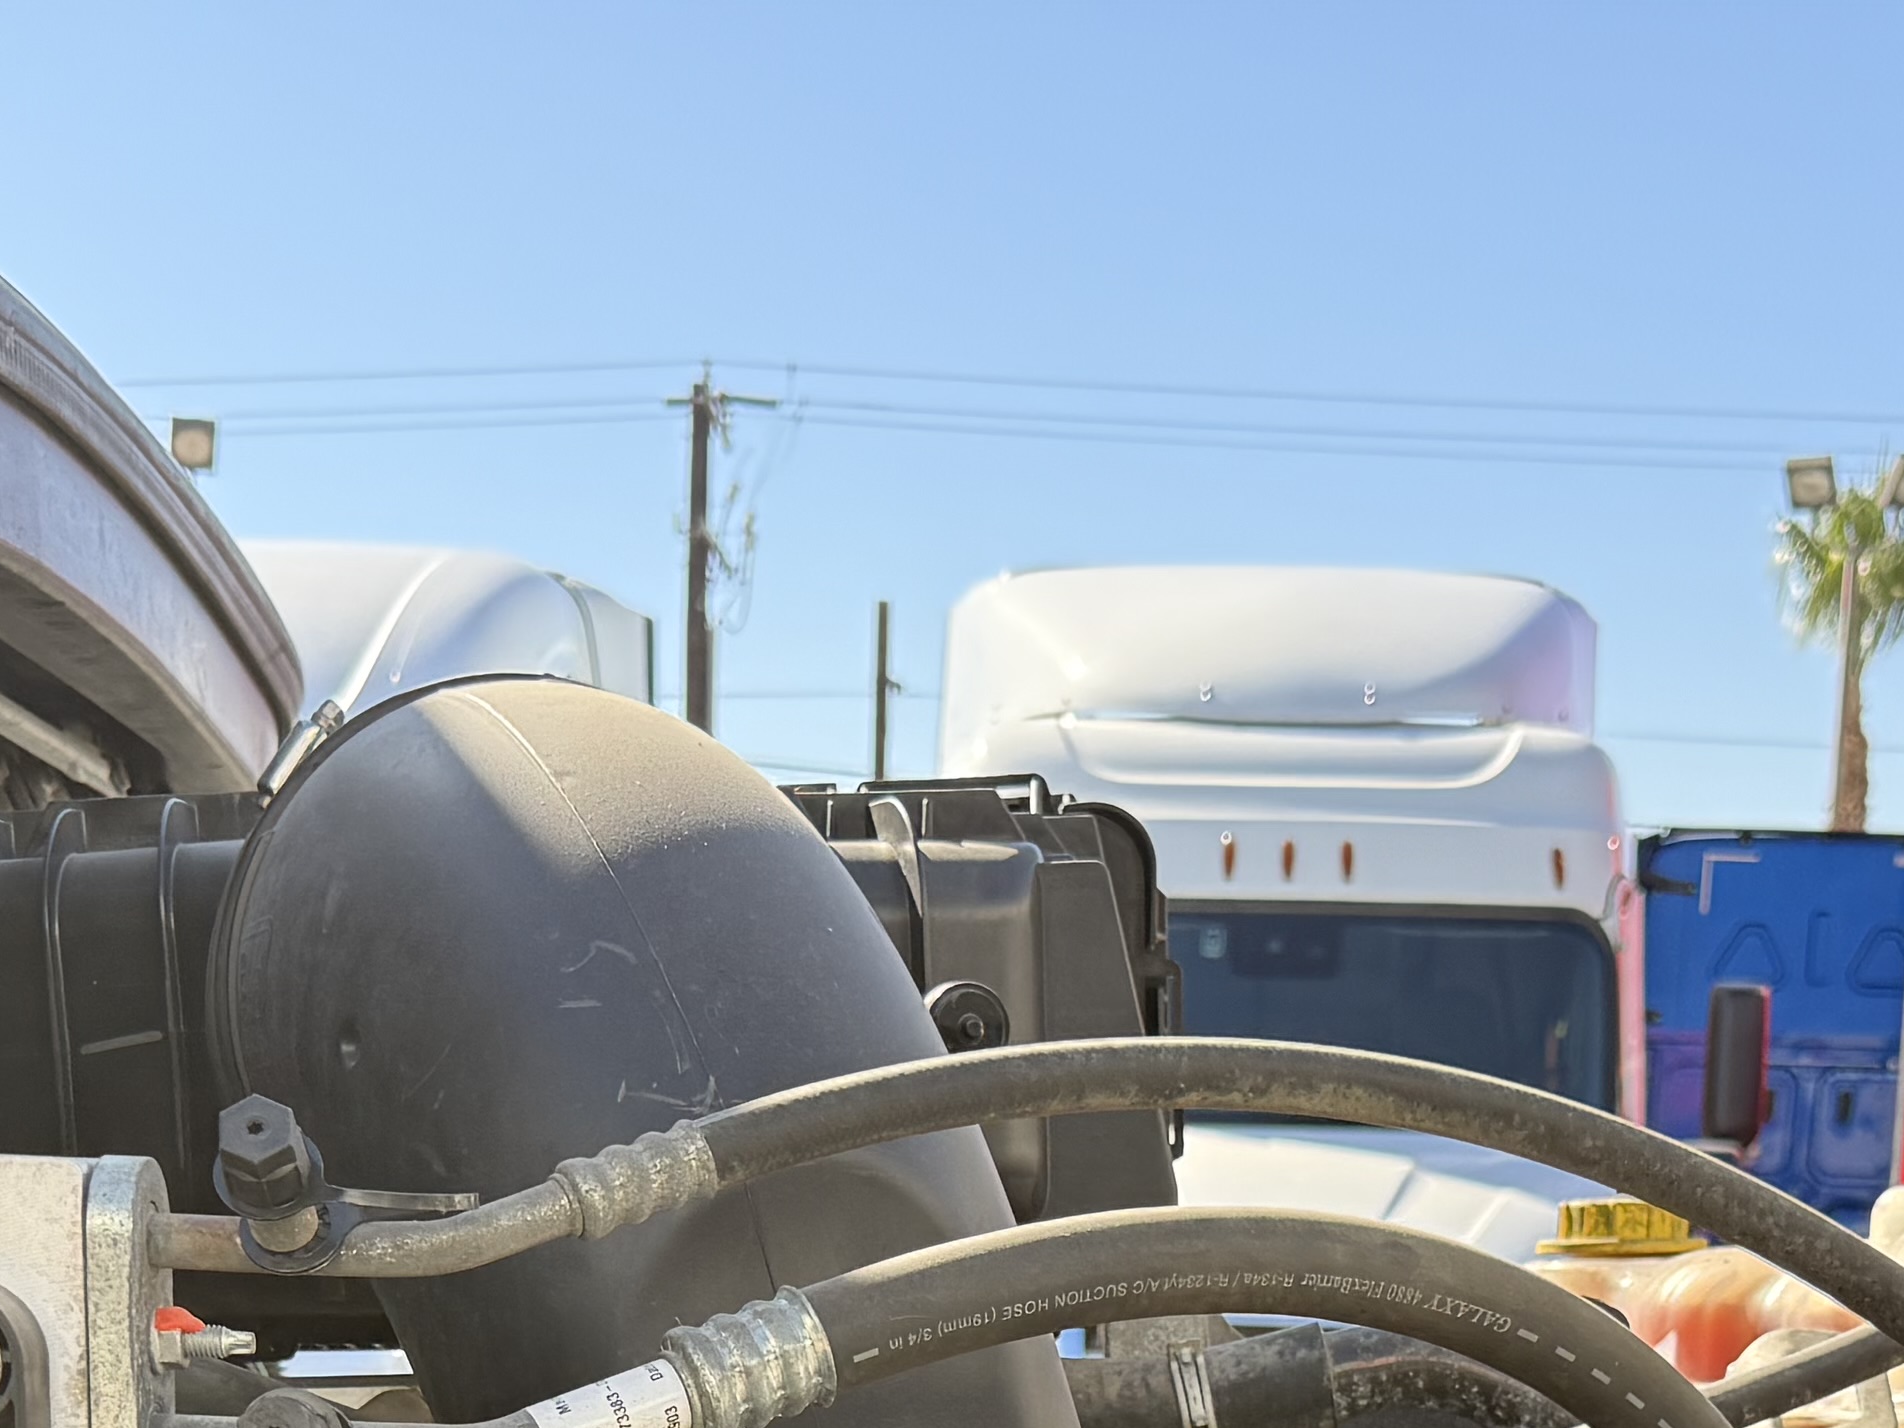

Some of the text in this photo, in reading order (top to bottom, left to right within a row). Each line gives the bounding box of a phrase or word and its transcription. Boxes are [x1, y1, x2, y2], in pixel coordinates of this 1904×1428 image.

[1054, 1281, 1128, 1309] SUCTION
[1133, 1276, 1160, 1295] A/C
[1300, 1272, 1385, 1299] FlexBarrier
[1387, 1283, 1423, 1306] 4880
[1001, 1298, 1049, 1321] HOSE
[1426, 1294, 1512, 1334] GALAXY
[937, 1307, 997, 1338] (19mm)
[889, 1338, 904, 1351] in
[907, 1326, 933, 1349] 3/4
